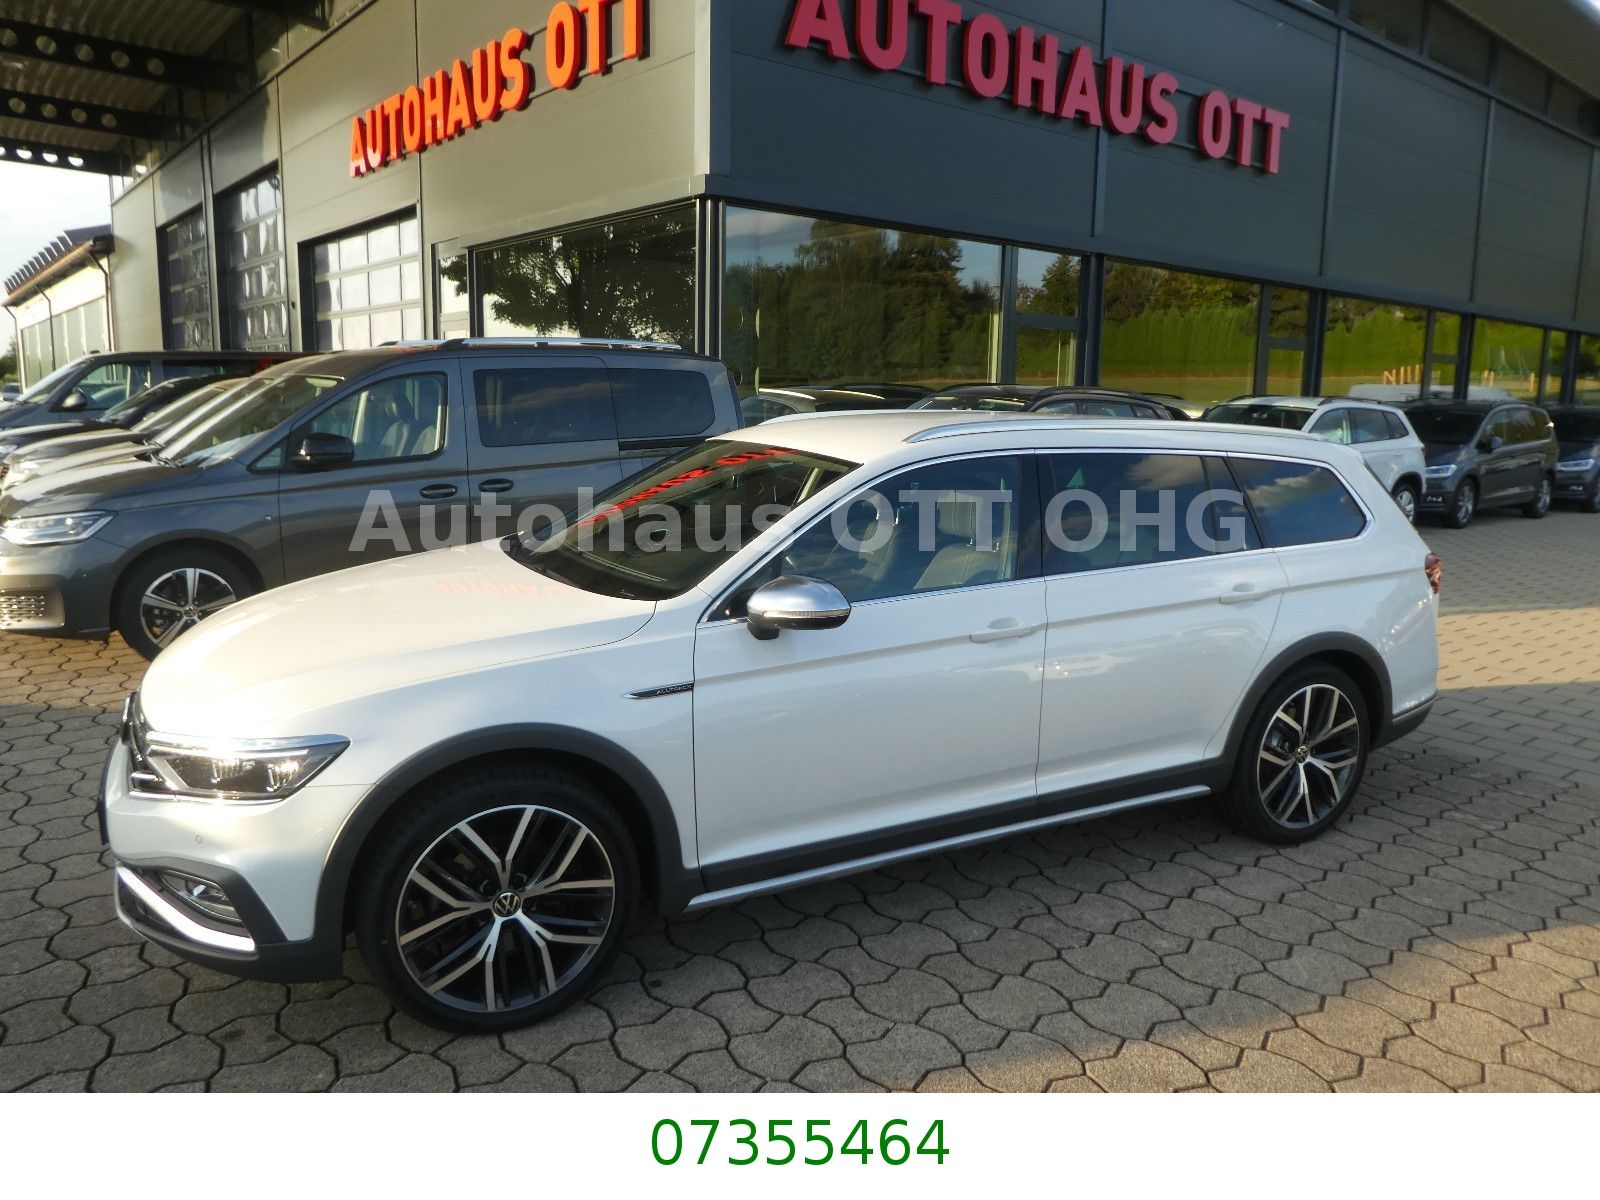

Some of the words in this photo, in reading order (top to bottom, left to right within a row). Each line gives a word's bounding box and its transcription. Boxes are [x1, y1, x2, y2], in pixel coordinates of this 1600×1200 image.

[350, 28, 533, 178] AUTOHAUS
[546, 0, 647, 89] OTT
[784, 0, 1180, 145] AUTOHAUS
[1197, 90, 1291, 175] OTT
